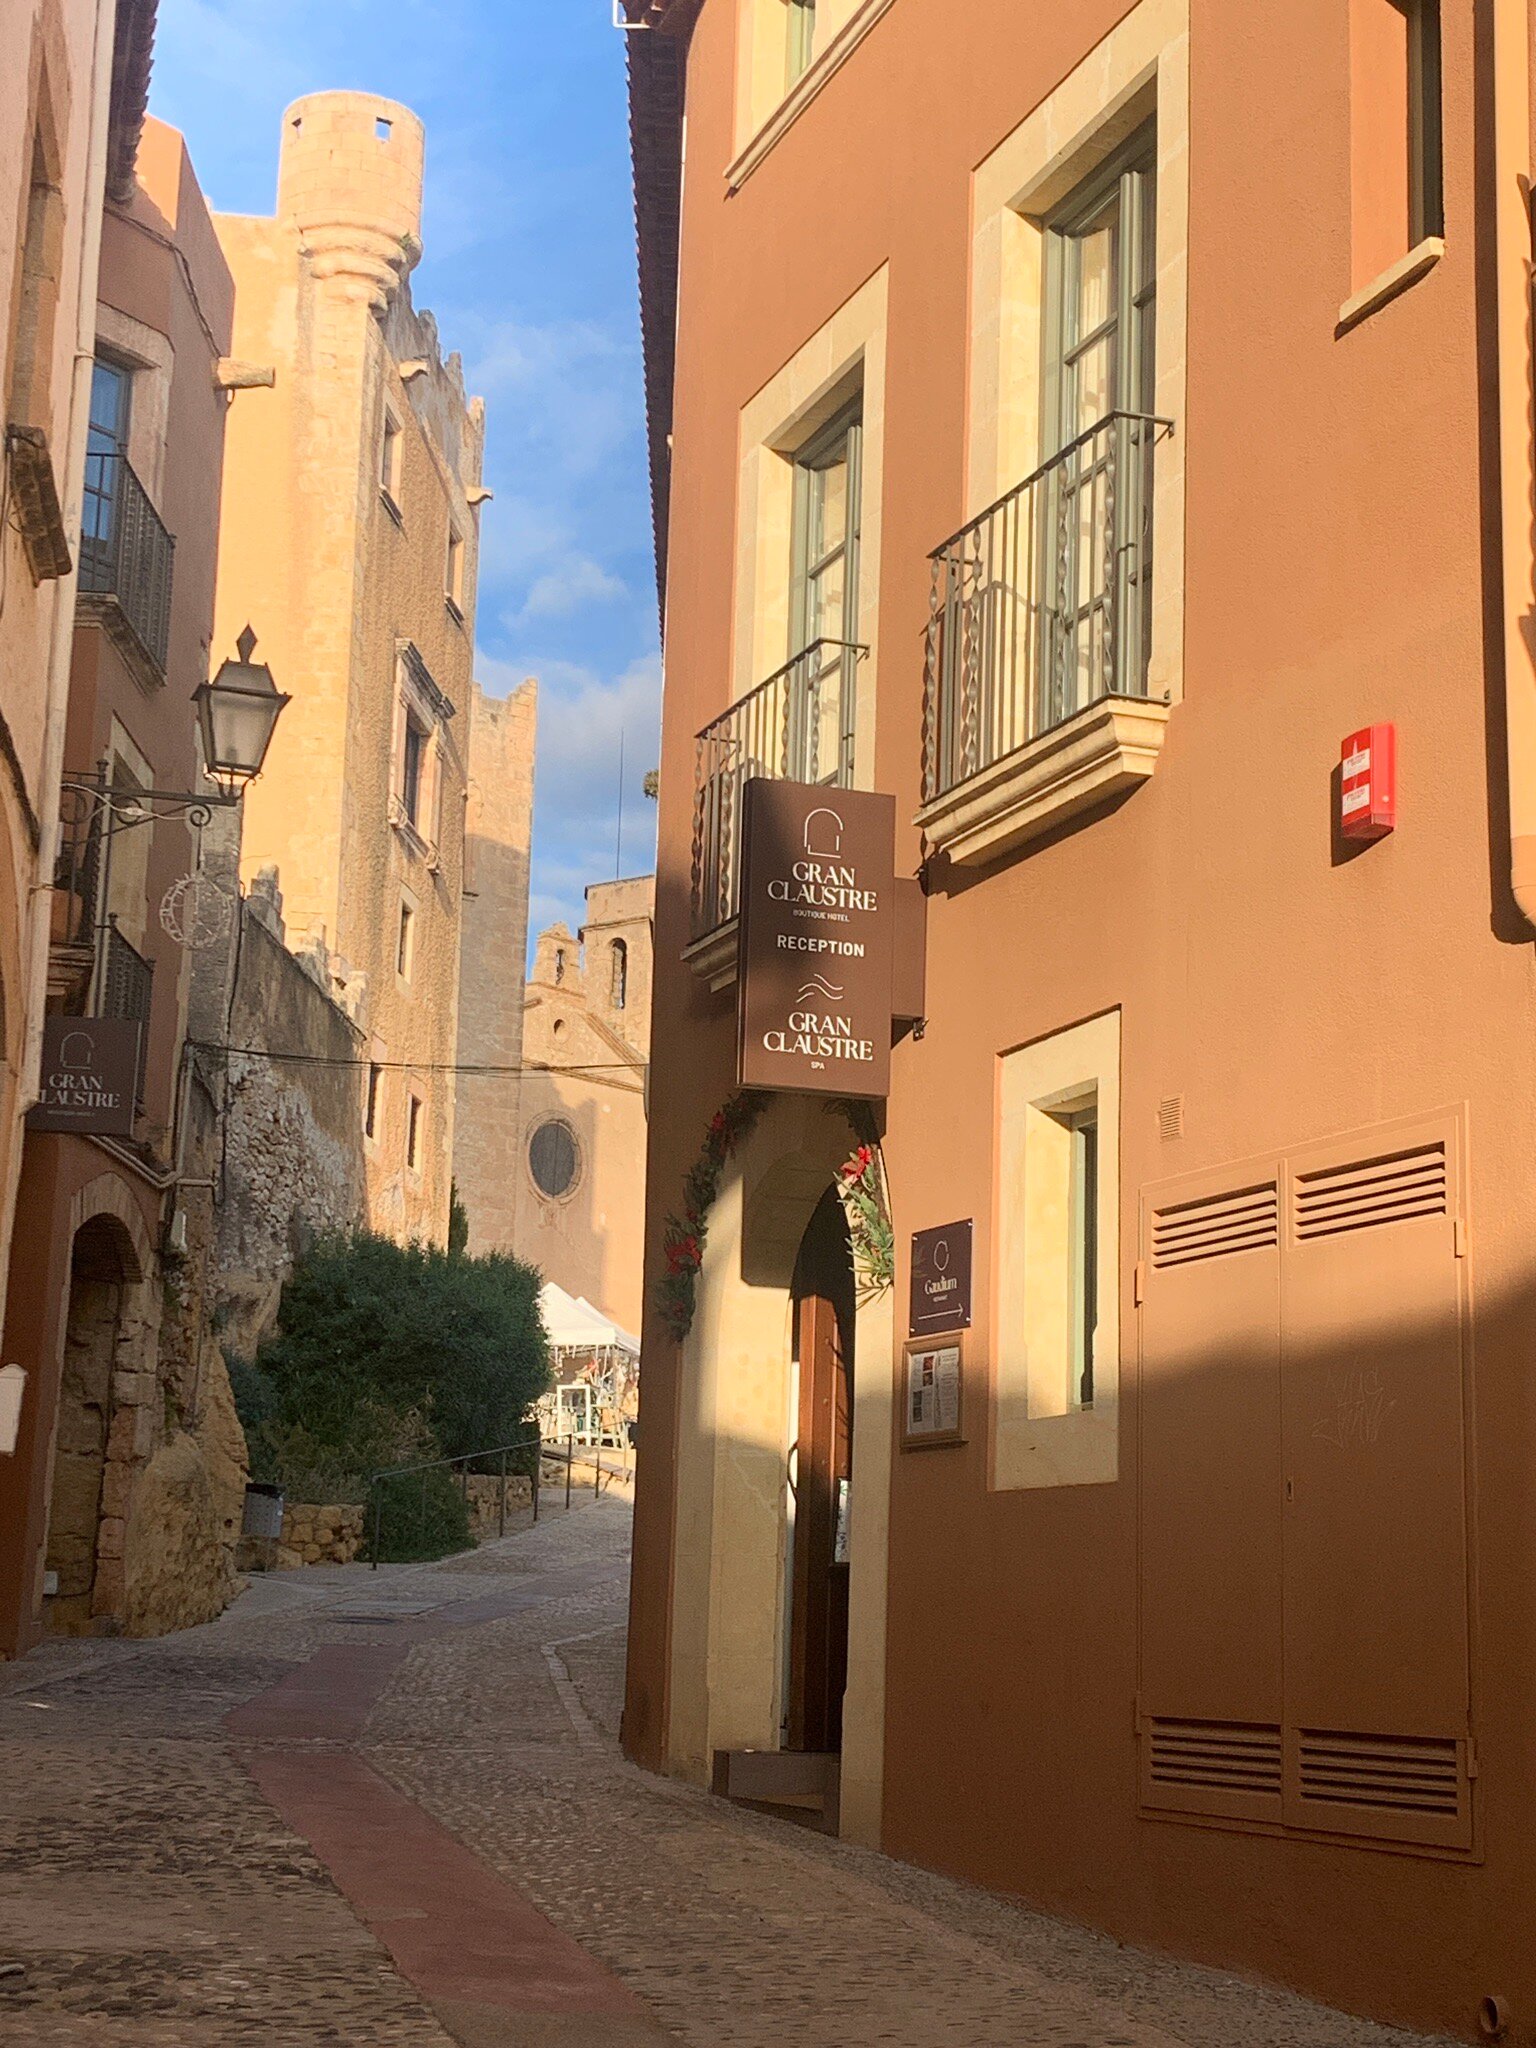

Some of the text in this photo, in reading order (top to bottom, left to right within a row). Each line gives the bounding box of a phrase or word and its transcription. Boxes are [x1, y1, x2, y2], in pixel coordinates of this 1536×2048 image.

[792, 861, 855, 886] GRAN
[767, 880, 877, 911] CLAUSTRE
[793, 909, 850, 922] BOUTIQUE HOTEL
[777, 935, 864, 957] RECEPTION
[788, 1011, 851, 1037] GRAN
[763, 1031, 873, 1061] CLAUSTRE
[810, 1061, 825, 1070] SPA
[49, 1073, 103, 1090] GRAN
[40, 1089, 120, 1108] LAUSTRE
